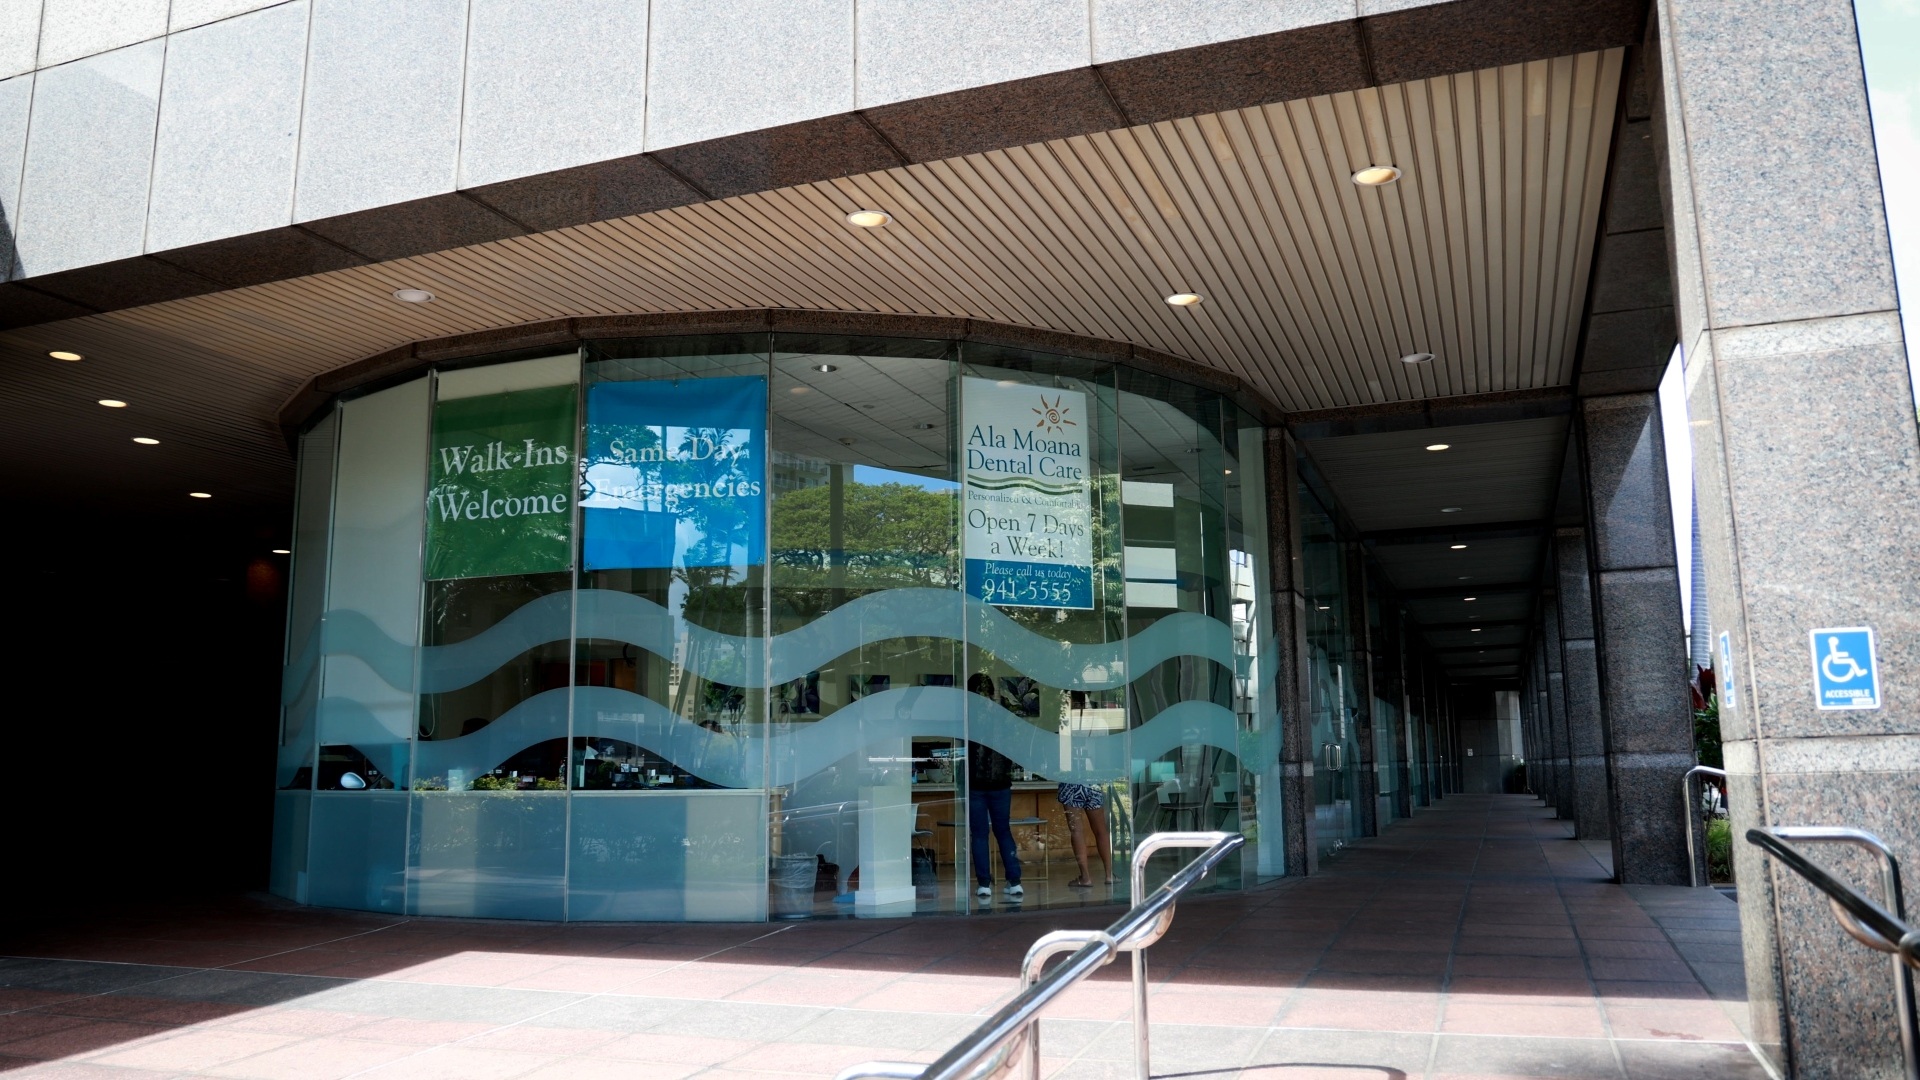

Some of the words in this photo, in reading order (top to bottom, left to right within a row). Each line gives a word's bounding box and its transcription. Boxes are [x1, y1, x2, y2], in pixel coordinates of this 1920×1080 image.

[610, 440, 679, 463] Same
[692, 437, 742, 467] Day
[967, 424, 1006, 449] Ala
[1013, 428, 1081, 457] Moana
[439, 438, 568, 476] Walk-Ins
[967, 448, 1033, 475] Dental
[1039, 456, 1082, 480] Care
[436, 489, 567, 523] Welcome
[593, 479, 760, 506] Emergencies
[968, 490, 1019, 504] Personalized
[1021, 496, 1032, 505] &
[968, 508, 1020, 534] Open
[1027, 513, 1036, 533] 7
[1043, 514, 1084, 540] Days
[990, 541, 1001, 555] a
[1006, 535, 1064, 559] Week!
[984, 562, 1014, 576] Please
[1016, 564, 1032, 577] call
[1034, 569, 1045, 578] us
[1047, 567, 1072, 581] today
[983, 578, 1071, 601] 941-5555
[1825, 688, 1871, 698] ACCESSIBLE
